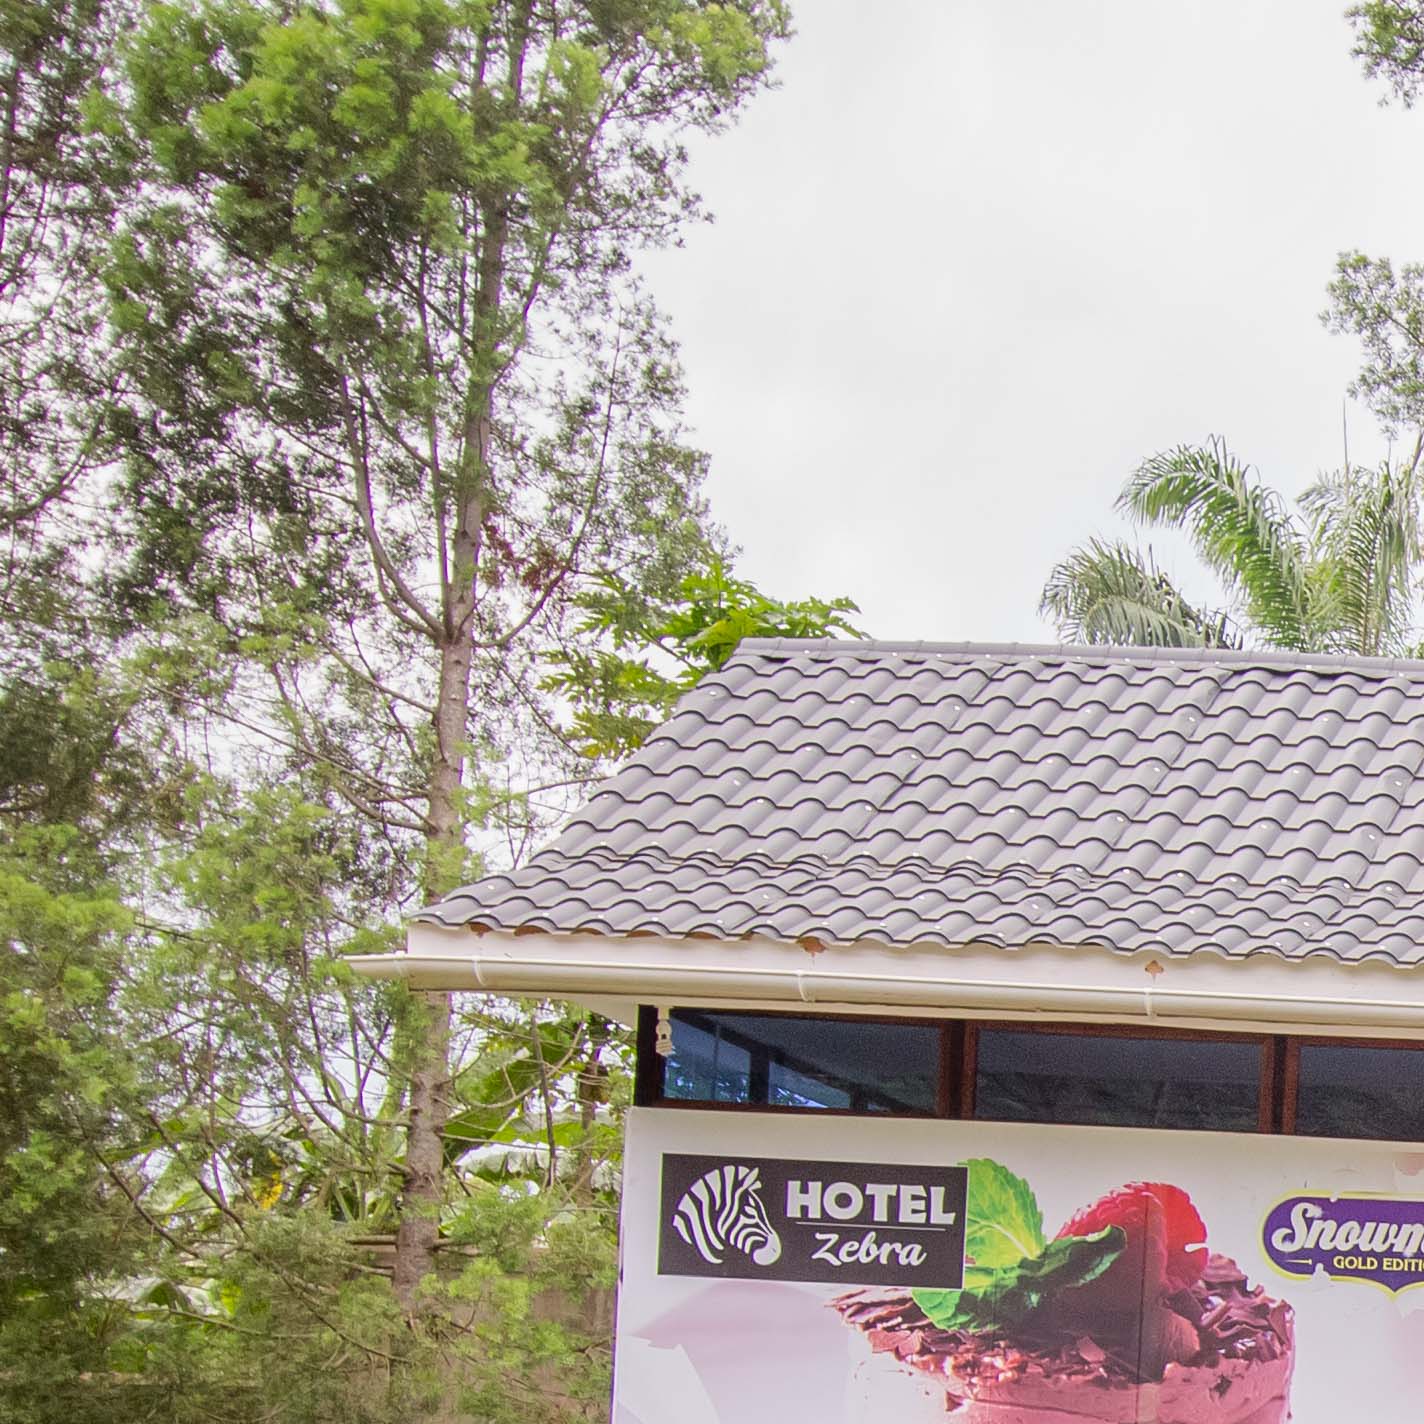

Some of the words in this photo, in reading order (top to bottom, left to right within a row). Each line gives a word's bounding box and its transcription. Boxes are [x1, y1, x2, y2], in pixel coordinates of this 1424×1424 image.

[786, 1180, 956, 1225] HOTEL
[811, 1231, 928, 1266] Zebra
[1333, 1255, 1378, 1270] GOLD
